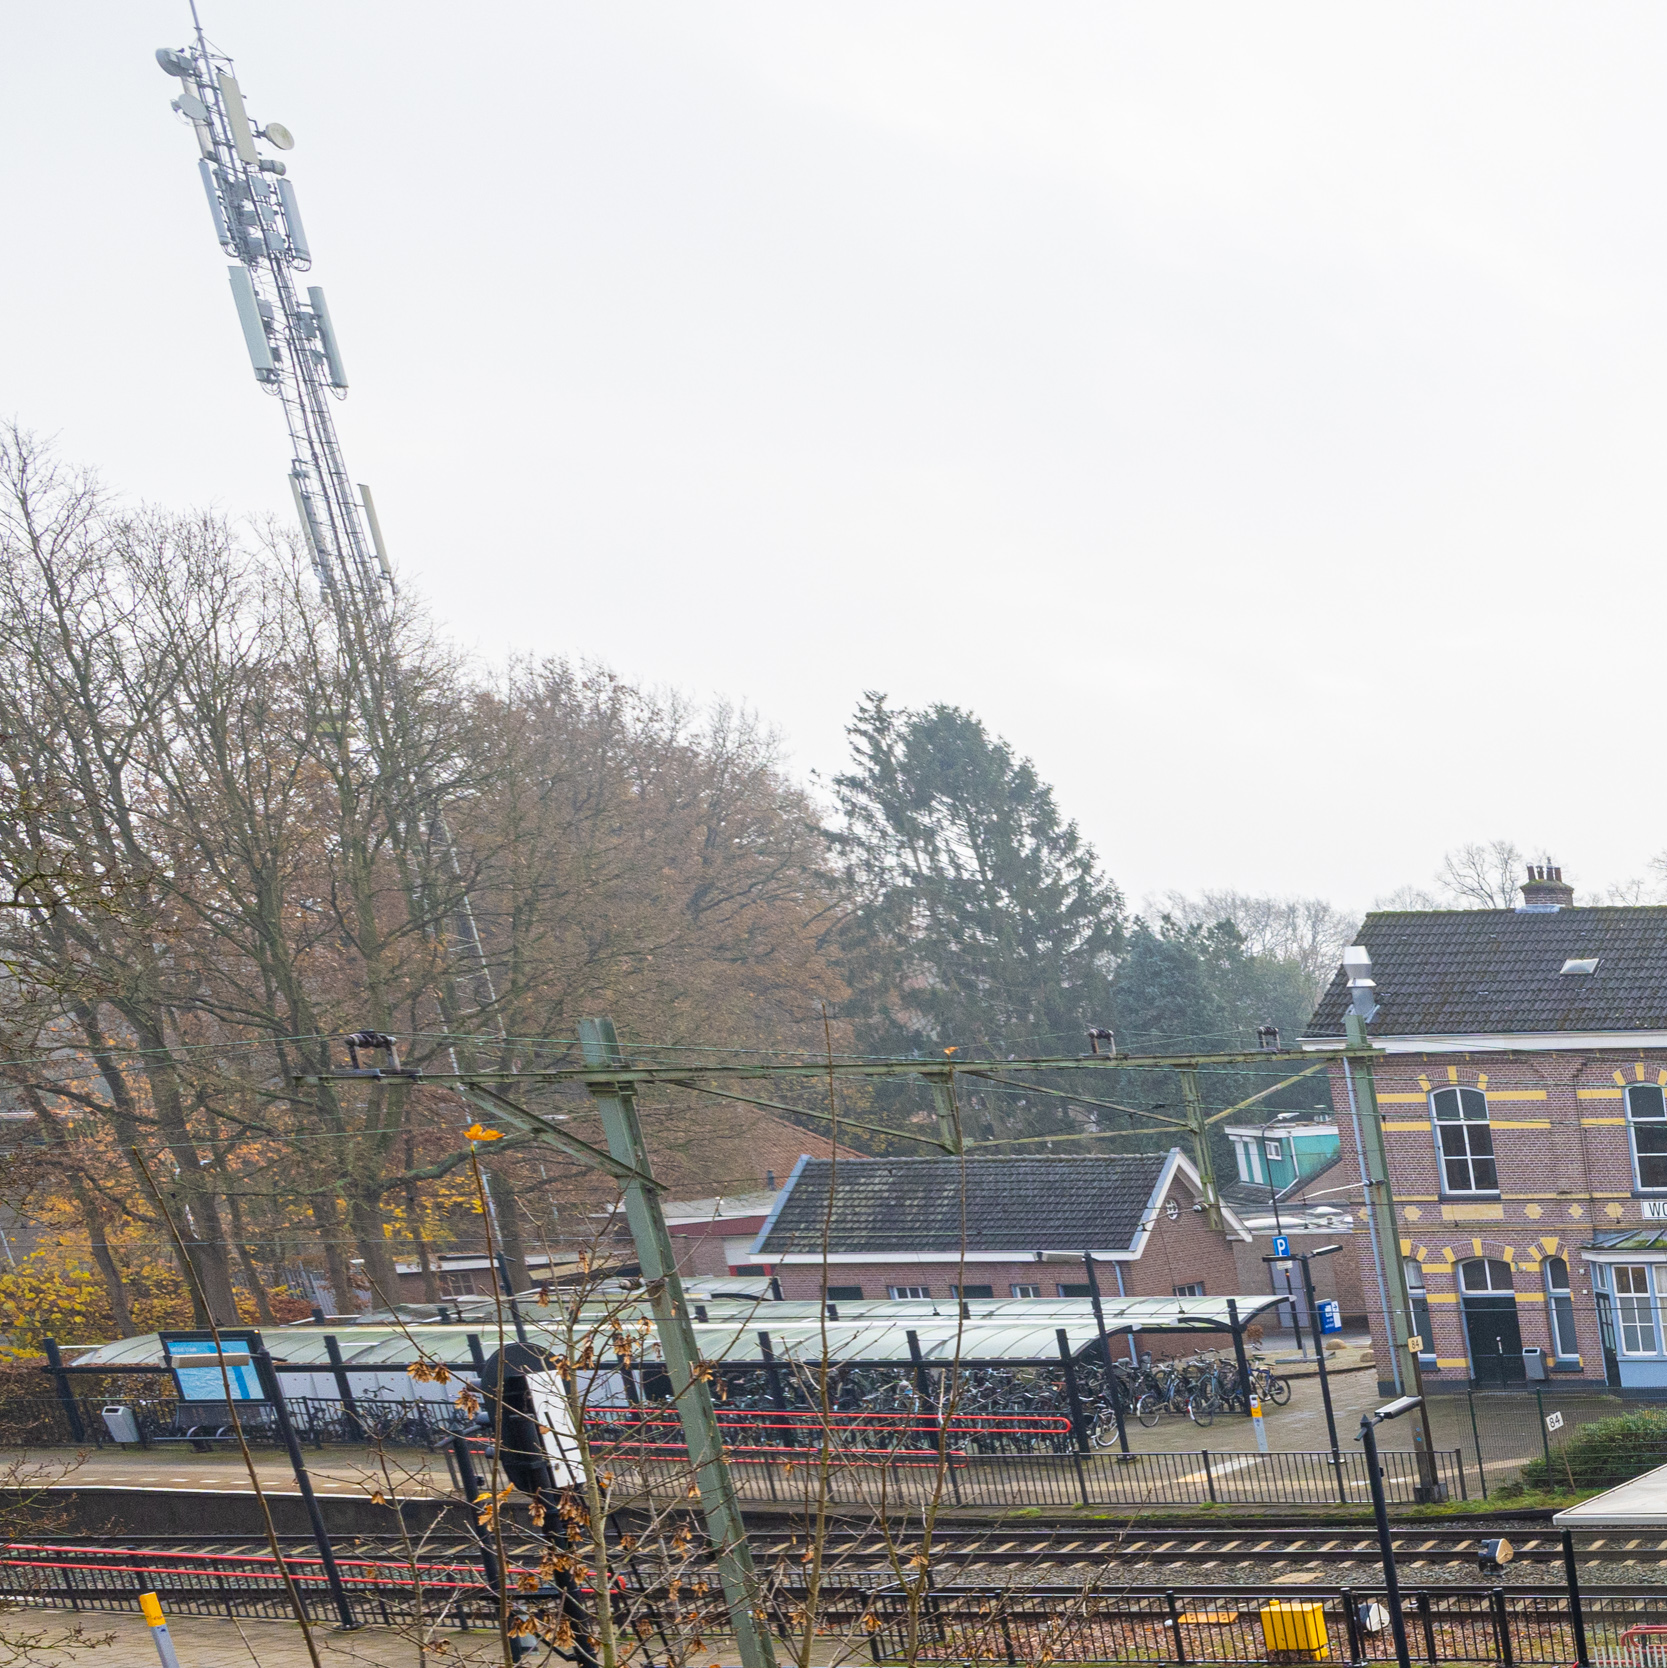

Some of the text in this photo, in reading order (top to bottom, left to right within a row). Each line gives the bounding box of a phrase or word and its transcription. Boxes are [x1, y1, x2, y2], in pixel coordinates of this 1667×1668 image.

[1276, 1239, 1286, 1256] P
[1411, 1339, 1420, 1350] 84
[1548, 1414, 1561, 1428] 84
